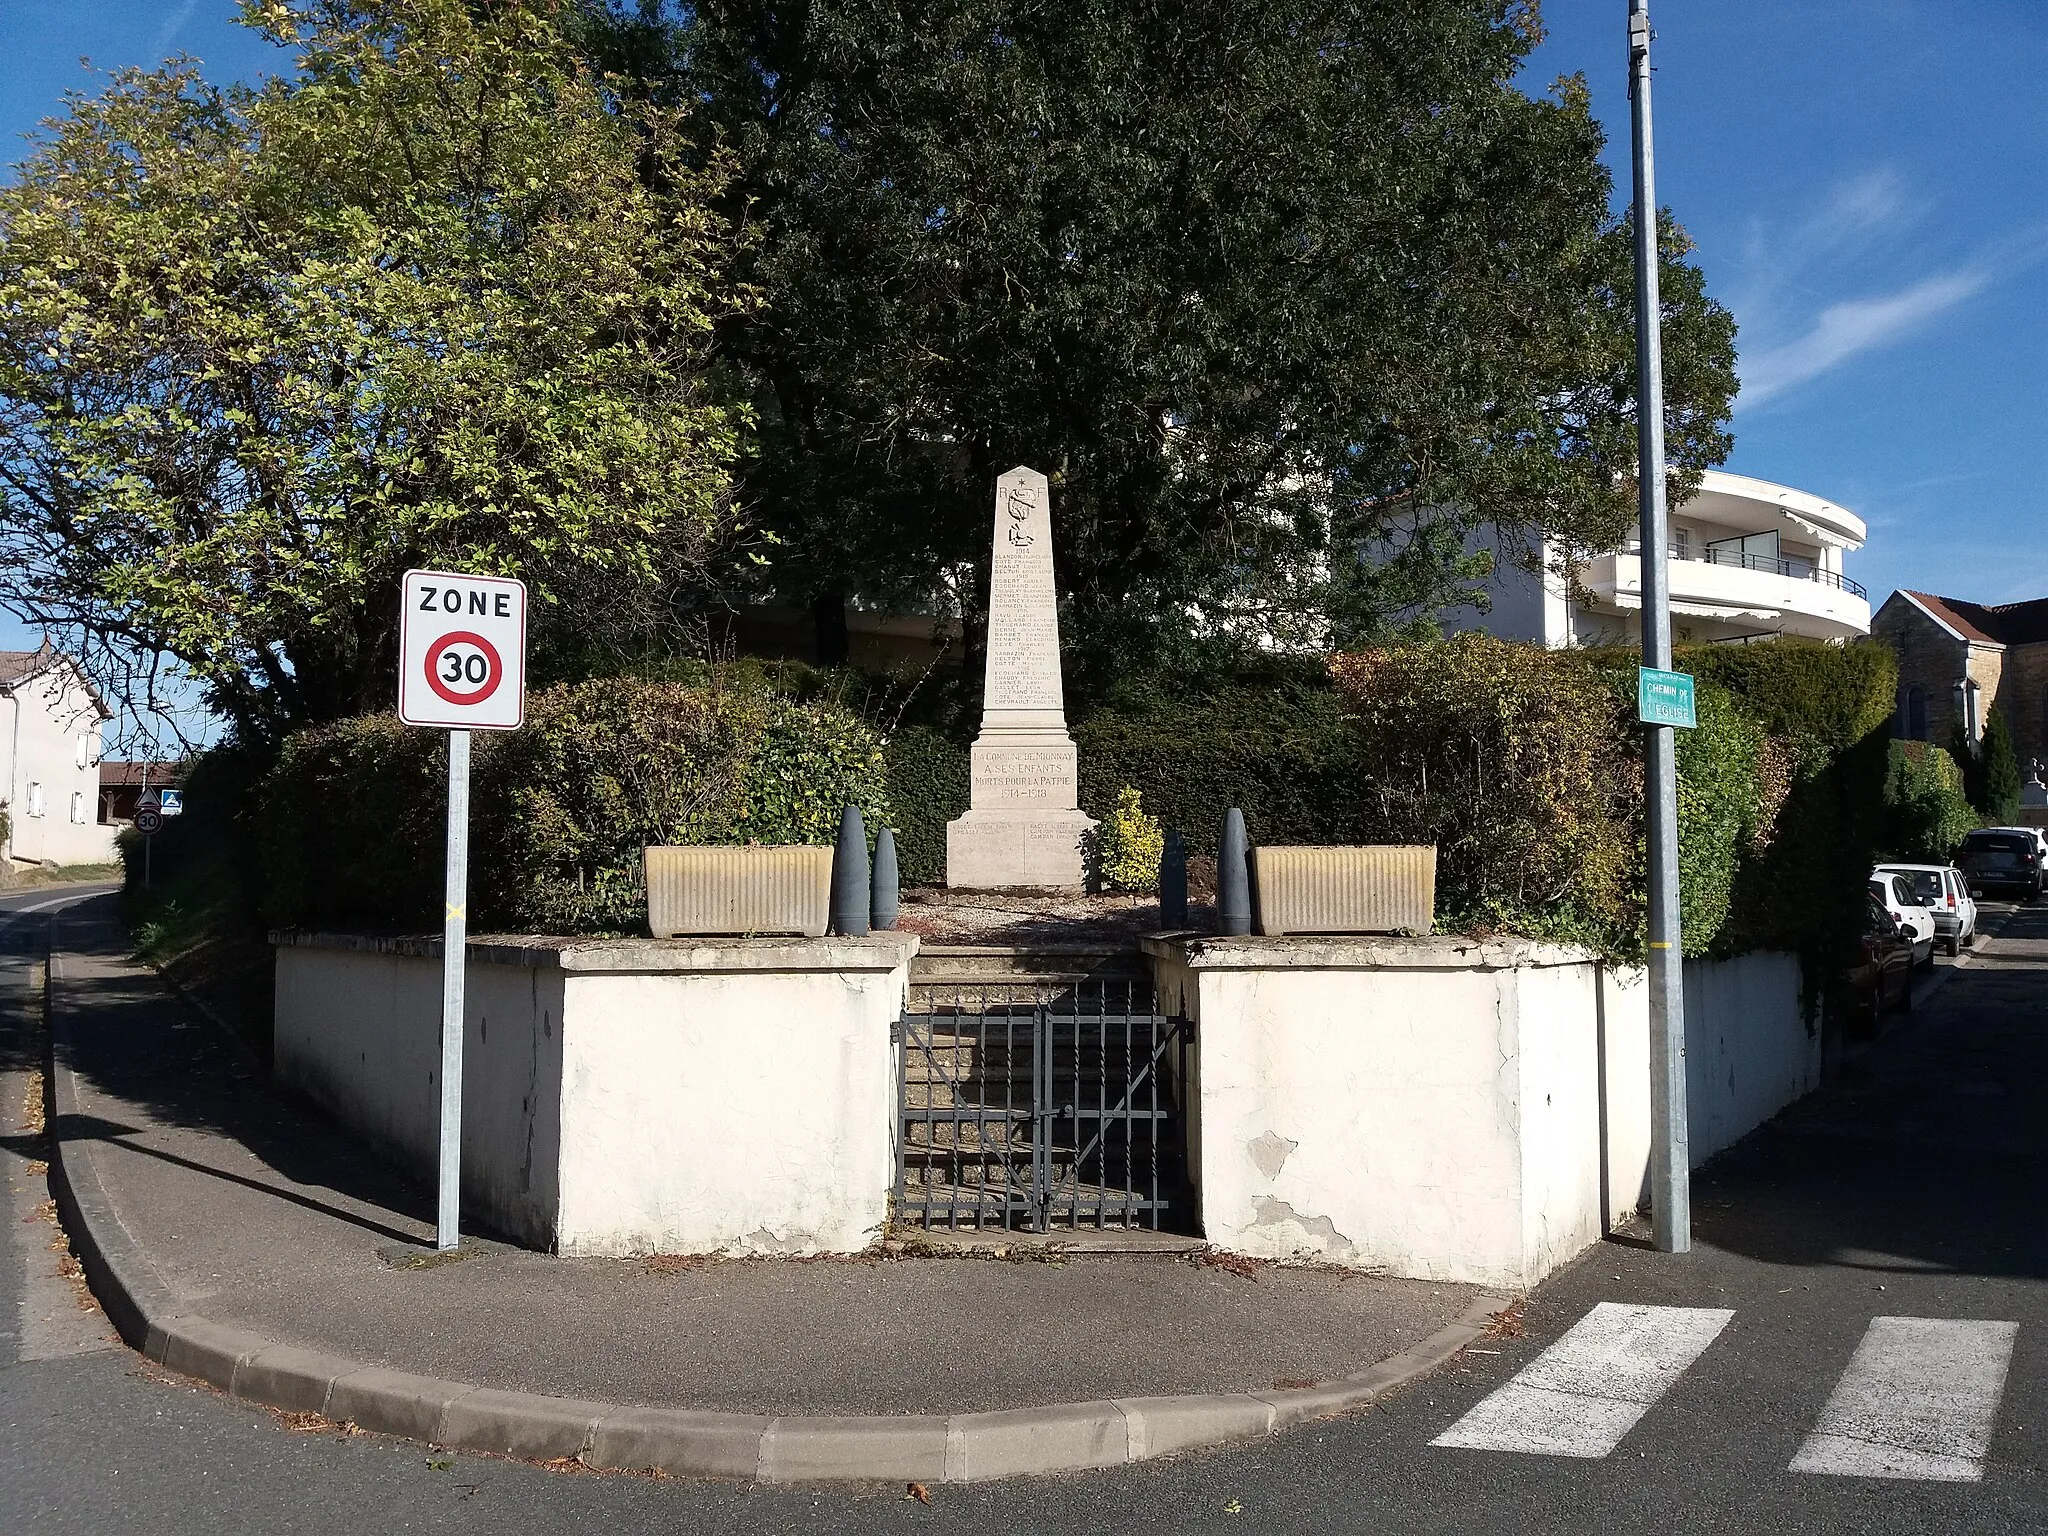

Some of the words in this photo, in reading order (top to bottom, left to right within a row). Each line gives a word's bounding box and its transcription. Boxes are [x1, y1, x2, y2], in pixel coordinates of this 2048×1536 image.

[999, 487, 1007, 498] R
[1037, 487, 1045, 498] F
[420, 586, 510, 618] ZONE
[442, 652, 487, 684] 30
[1647, 682, 1676, 696] CHEMIN
[1680, 689, 1688, 697] DE
[986, 752, 1022, 761] COMMUNE
[1024, 752, 1035, 760] DE
[1036, 752, 1074, 760] MIONNAY
[984, 764, 992, 774] A
[994, 764, 1015, 774] SES
[1018, 764, 1062, 774] ENFANTS
[975, 777, 1004, 786] MORTS
[1005, 778, 1027, 786] POUR
[1028, 778, 1039, 786] LA
[1040, 776, 1071, 786] PATRIE
[140, 816, 156, 828] 30
